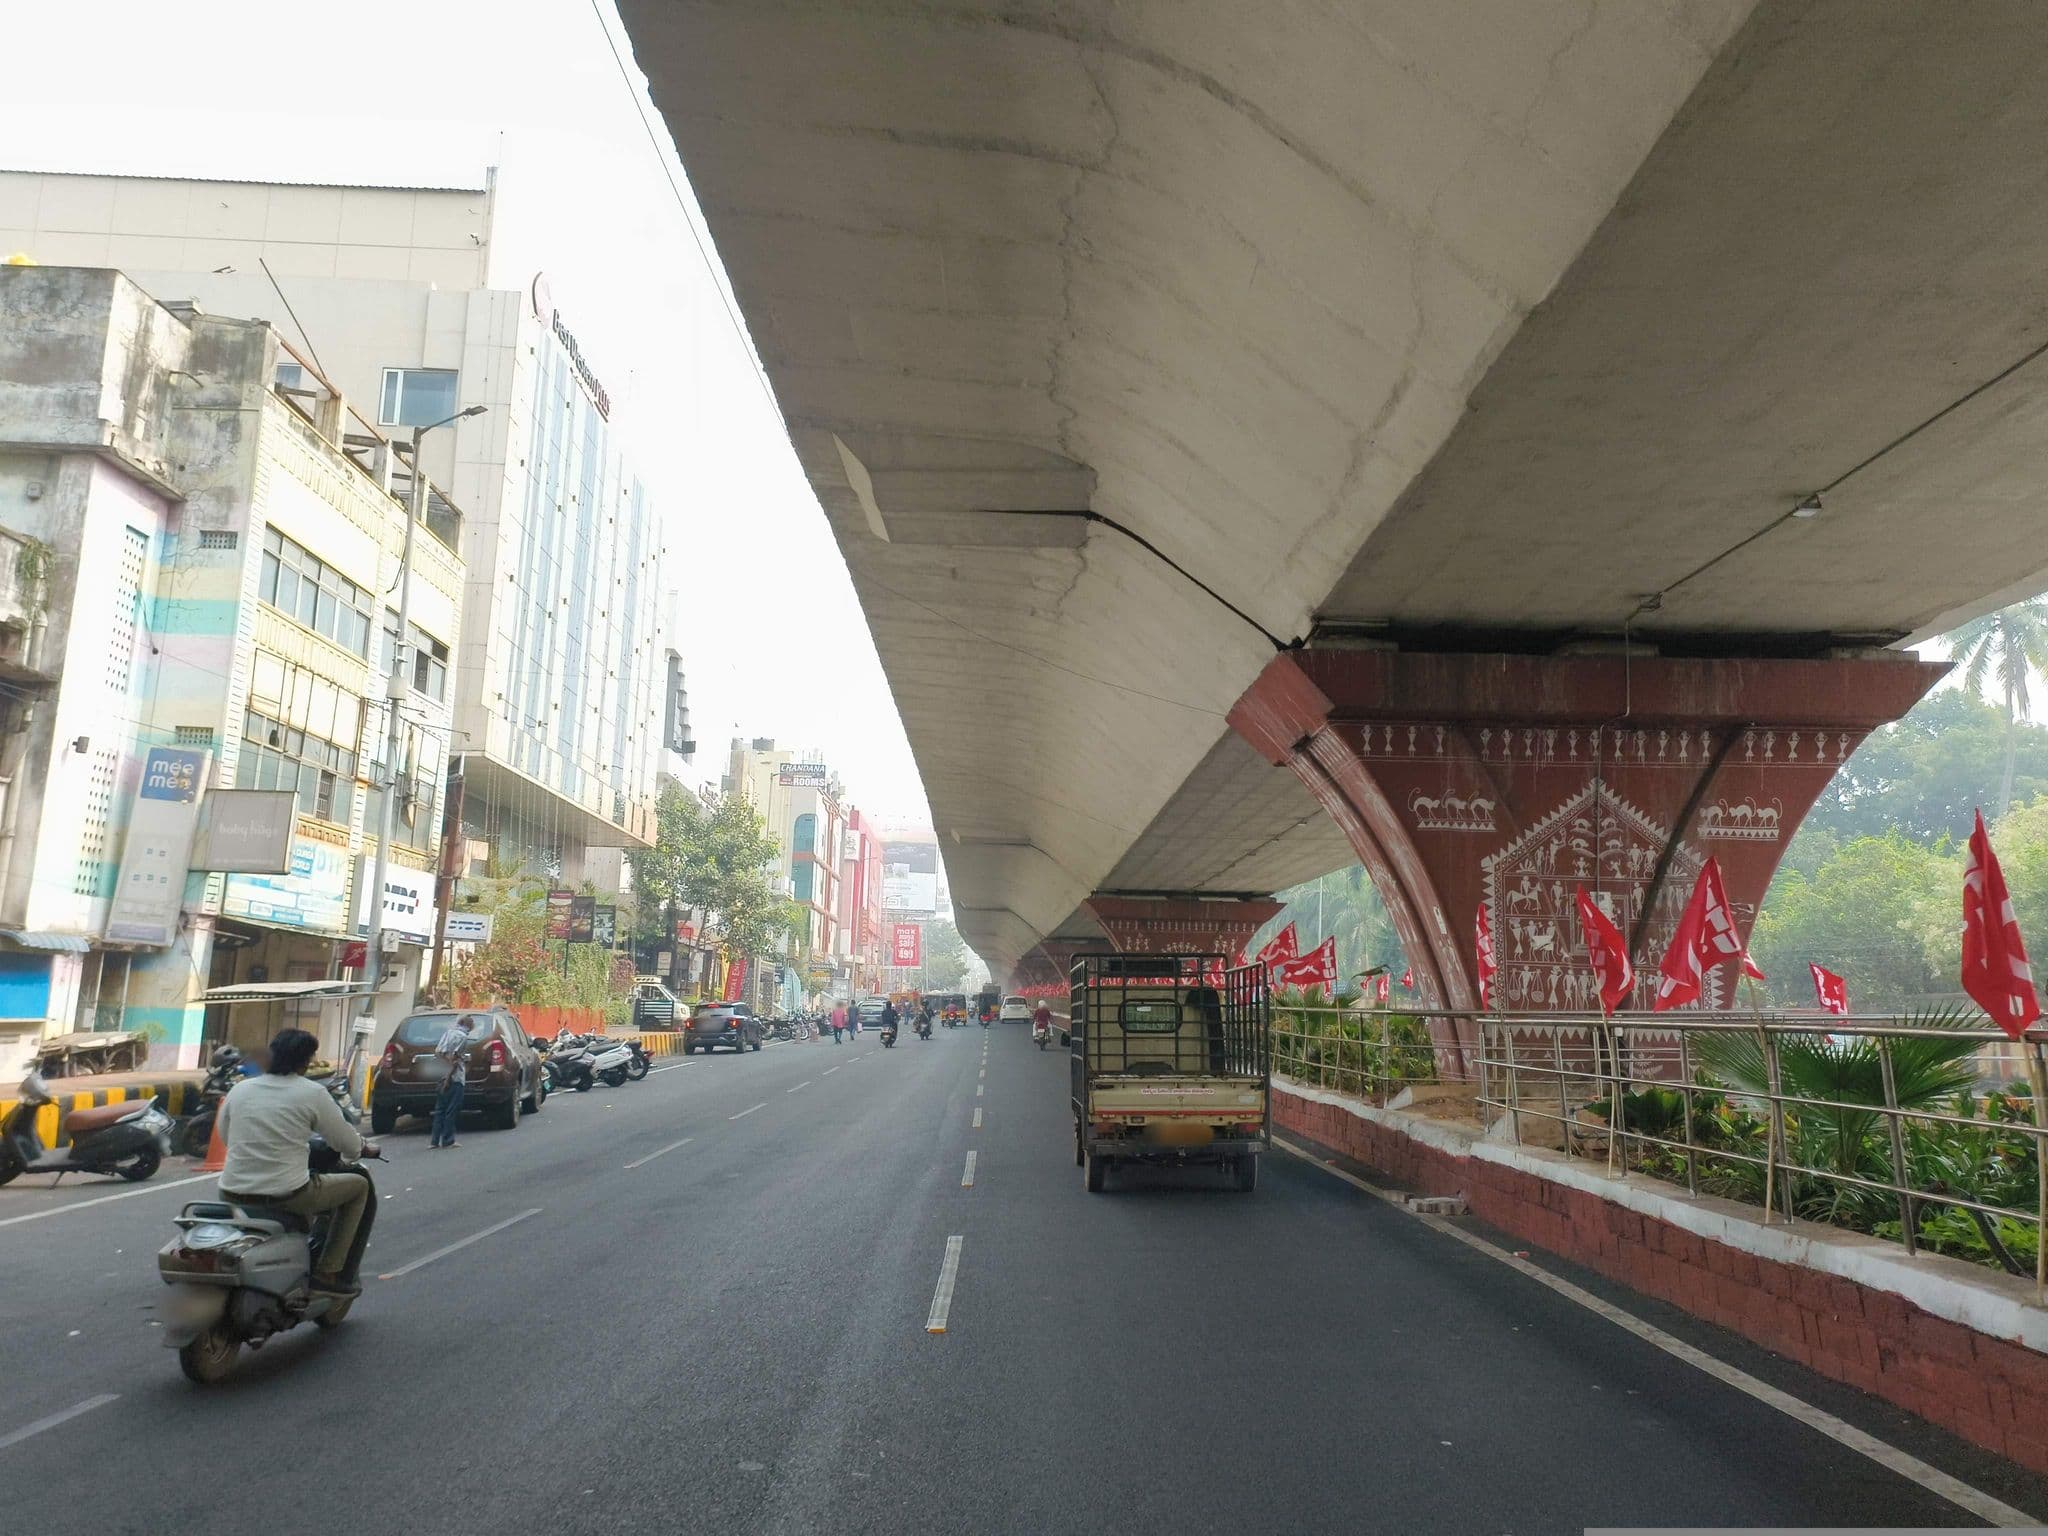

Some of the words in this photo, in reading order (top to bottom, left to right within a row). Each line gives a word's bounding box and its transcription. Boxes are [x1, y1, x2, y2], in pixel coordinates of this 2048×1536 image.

[152, 760, 194, 774] mee
[781, 764, 825, 773] CHANDANA
[793, 777, 825, 787] ROOMS
[447, 920, 486, 931] DTDC
